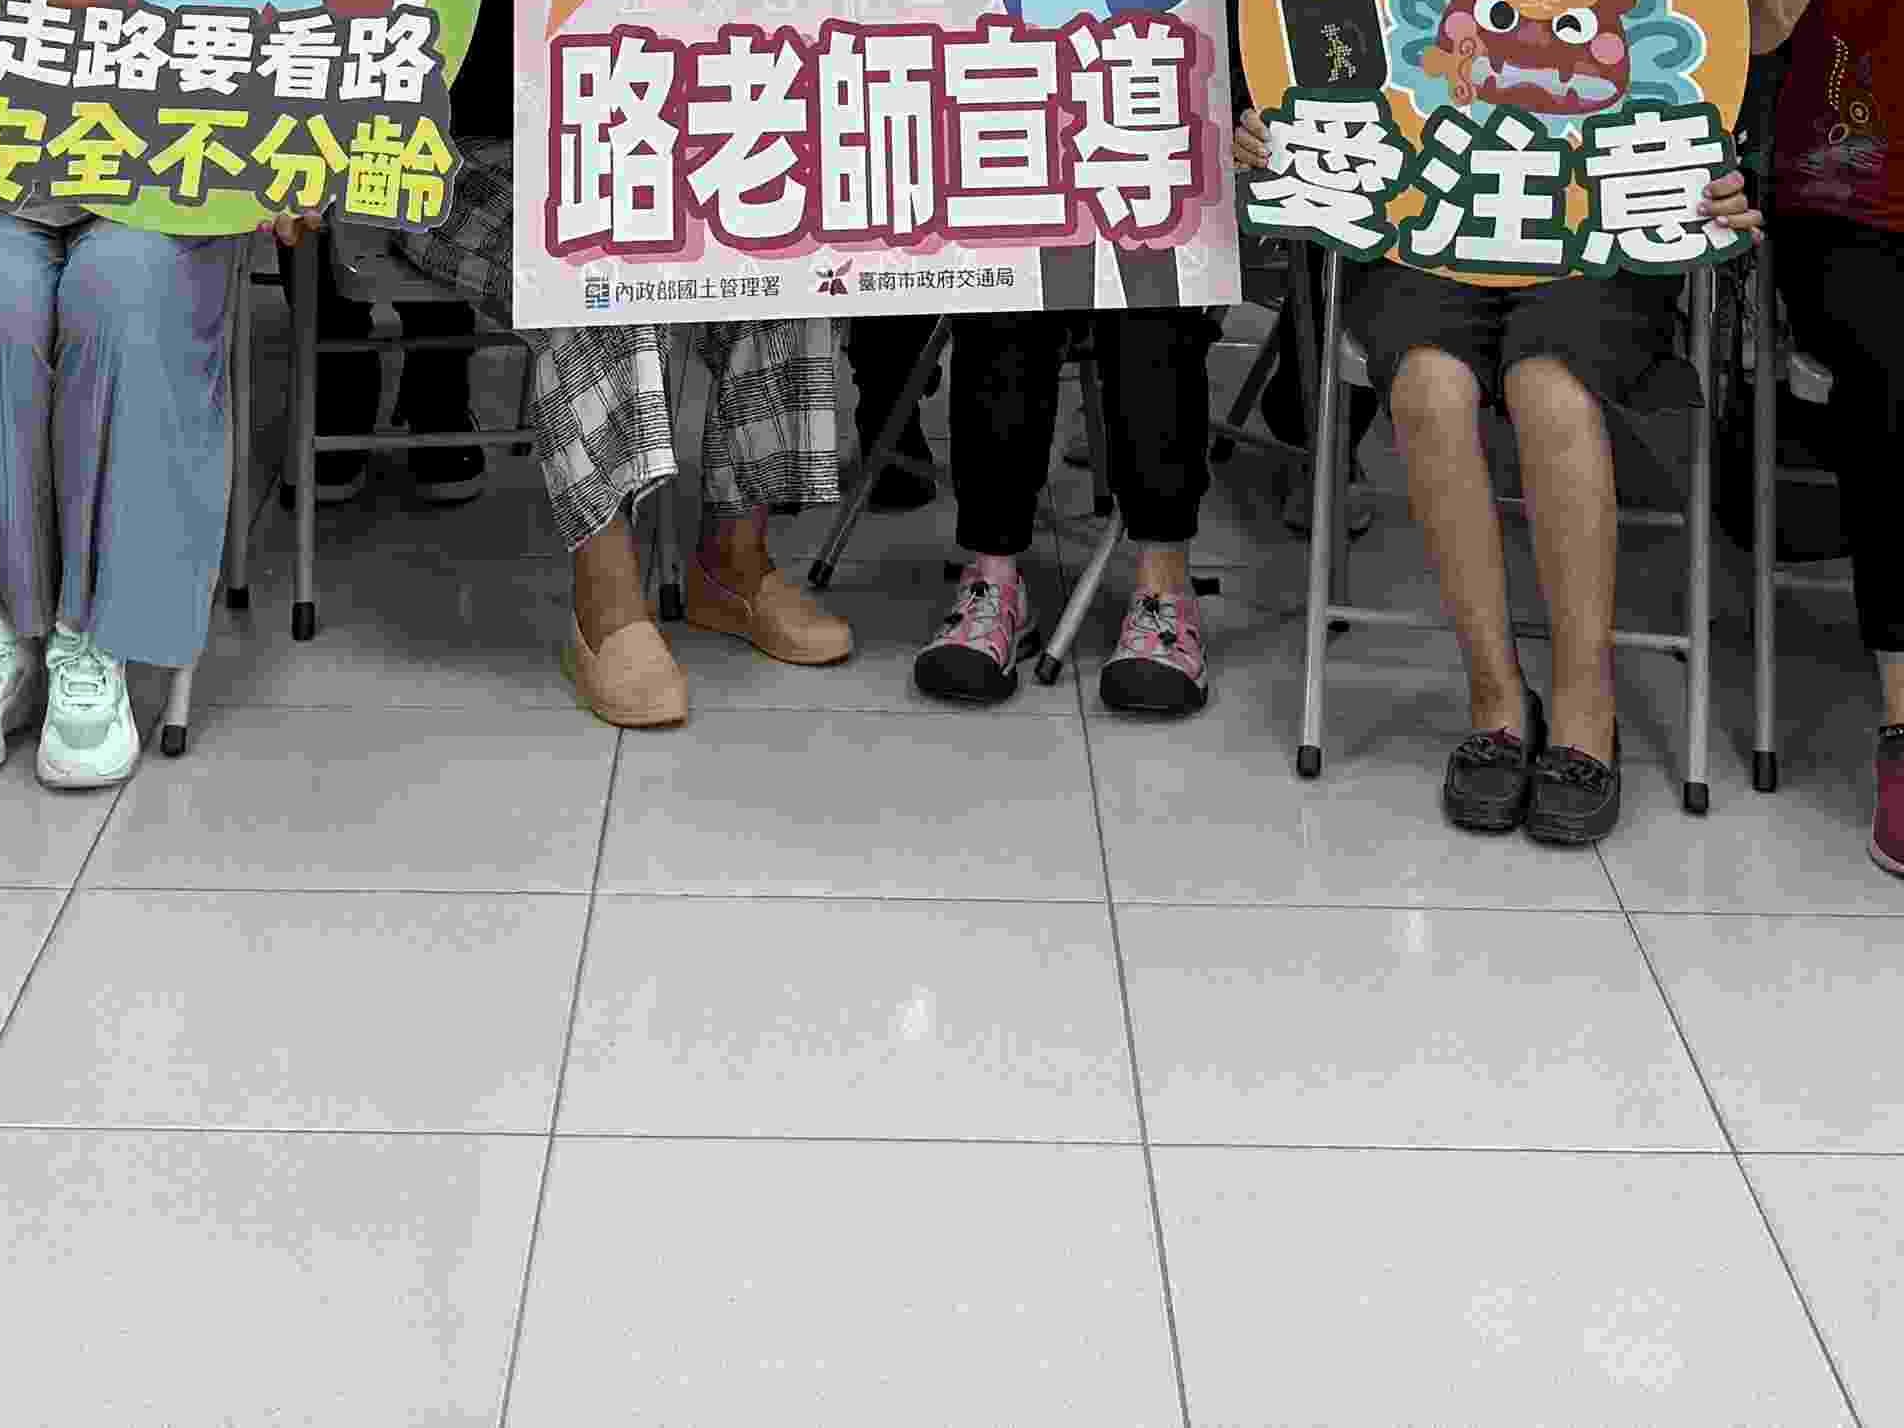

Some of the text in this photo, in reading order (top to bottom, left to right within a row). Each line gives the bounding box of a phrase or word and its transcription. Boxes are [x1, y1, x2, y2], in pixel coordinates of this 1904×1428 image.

[557, 23, 1193, 244] 路老師宣導
[1247, 99, 1738, 264] 愛注意
[858, 267, 1016, 293] 臺南市政府交通局
